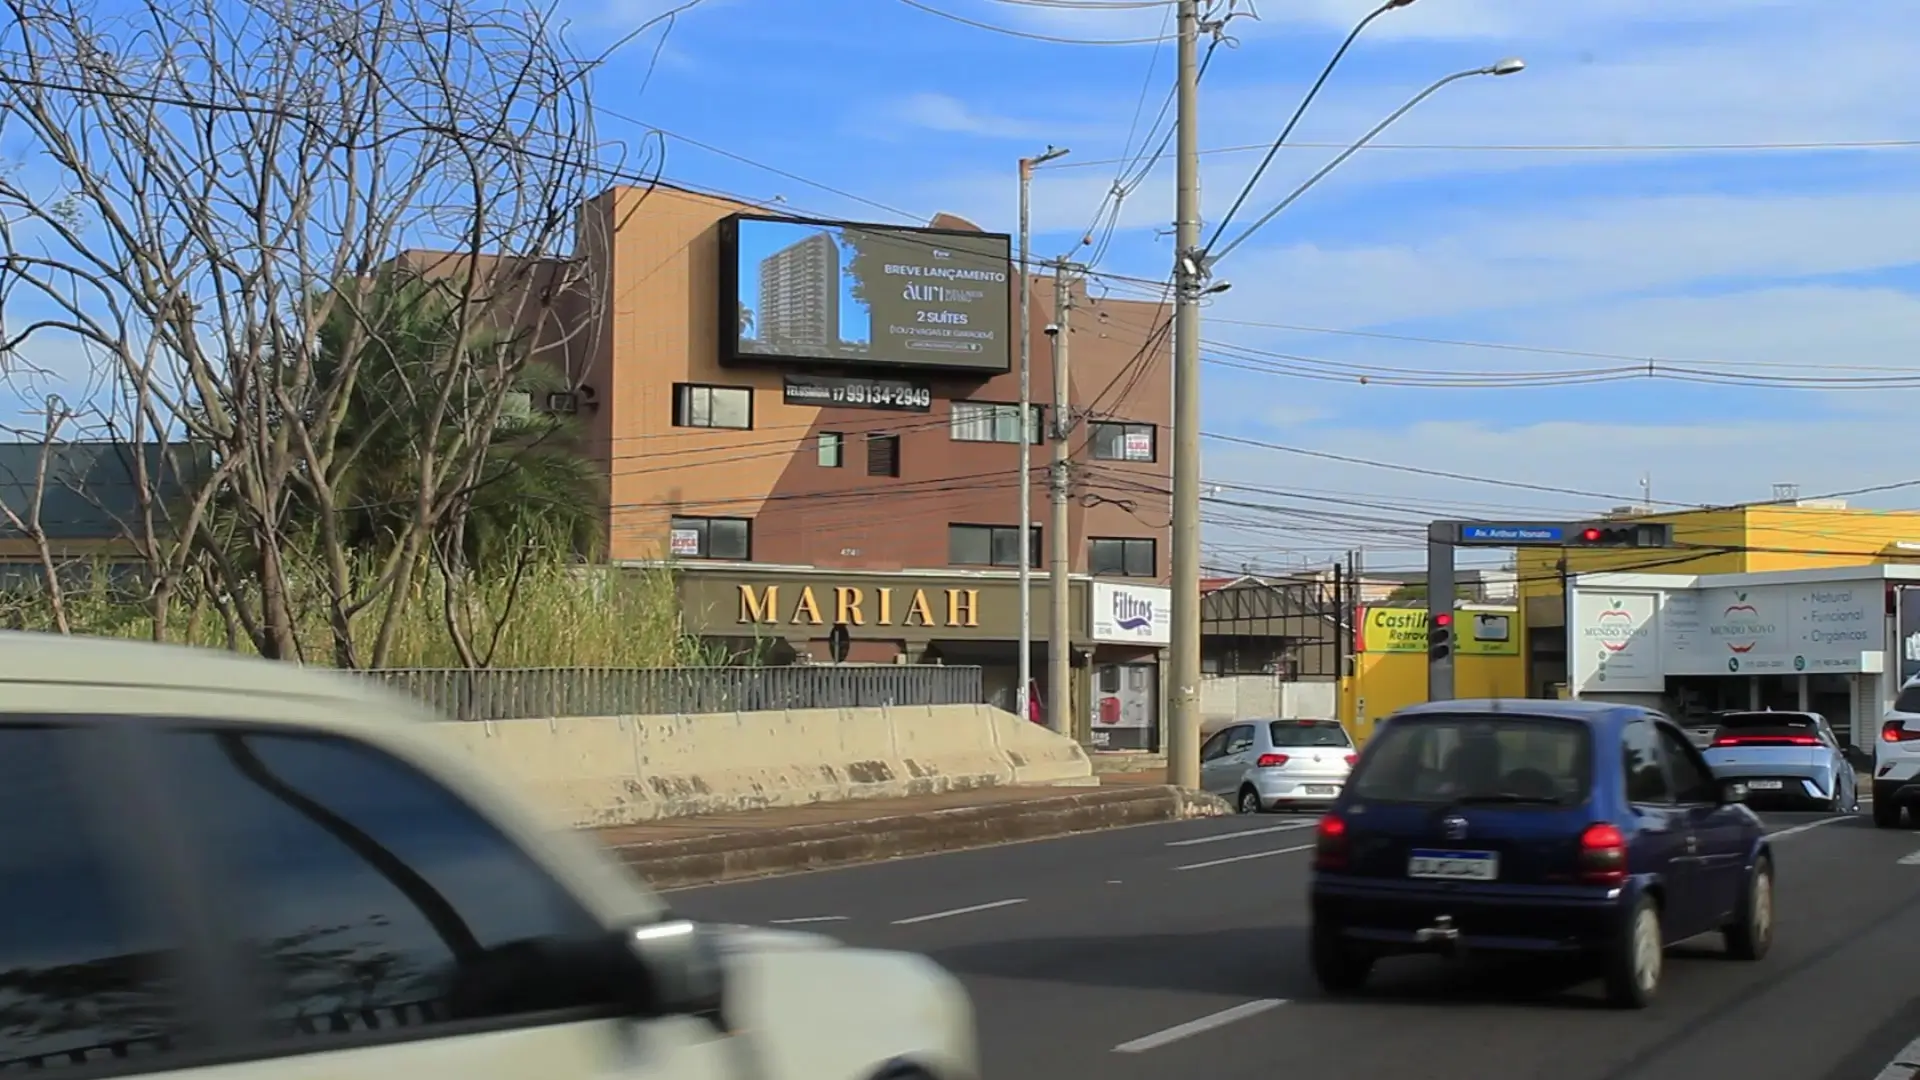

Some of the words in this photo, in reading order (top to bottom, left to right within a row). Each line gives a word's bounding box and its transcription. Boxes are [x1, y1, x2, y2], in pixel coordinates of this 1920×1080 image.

[884, 264, 921, 276] BREVE
[923, 266, 1006, 282] LANÇAMENTO
[916, 310, 926, 322] 2
[927, 310, 969, 325] SUÍTES
[846, 384, 931, 407] 99134-2949
[736, 583, 981, 627] MARIAH
[1112, 590, 1153, 622] Filtros
[1375, 611, 1429, 628] Castilh
